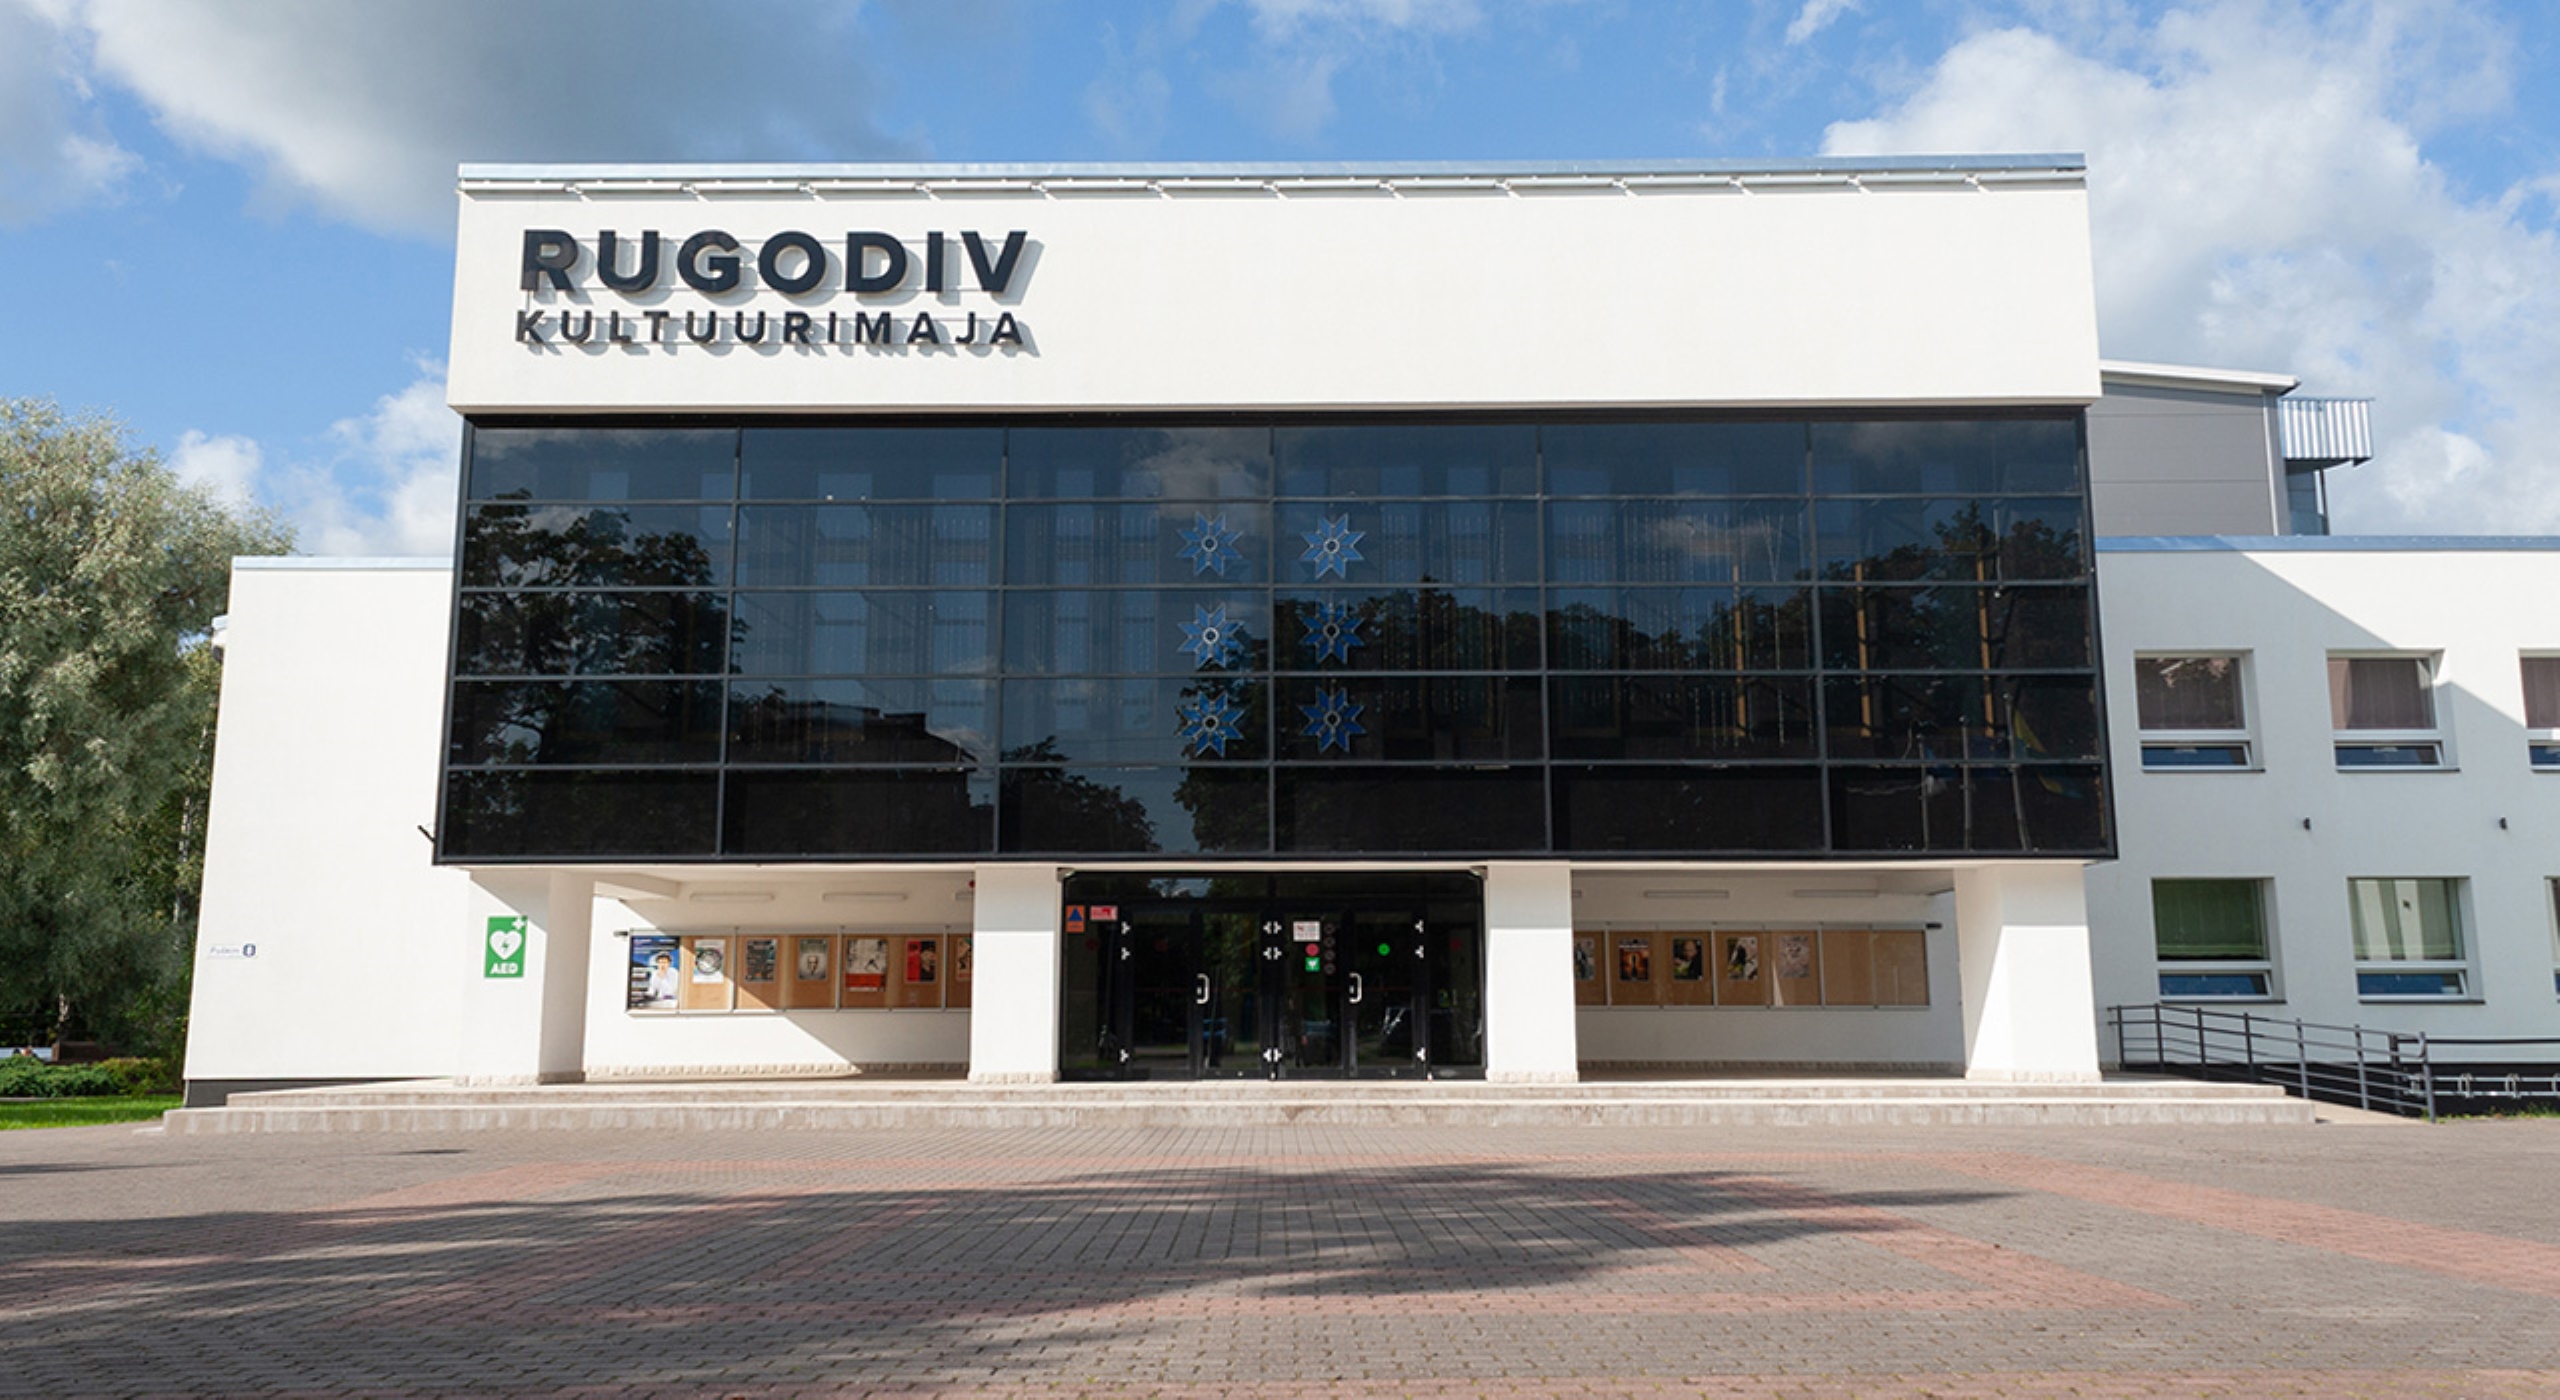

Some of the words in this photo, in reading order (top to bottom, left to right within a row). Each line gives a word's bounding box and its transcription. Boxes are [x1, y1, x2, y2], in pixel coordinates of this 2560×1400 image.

[521, 230, 1027, 294] RUGODIV
[517, 310, 1023, 346] KULTUURIMAJA
[490, 962, 519, 975] AED
